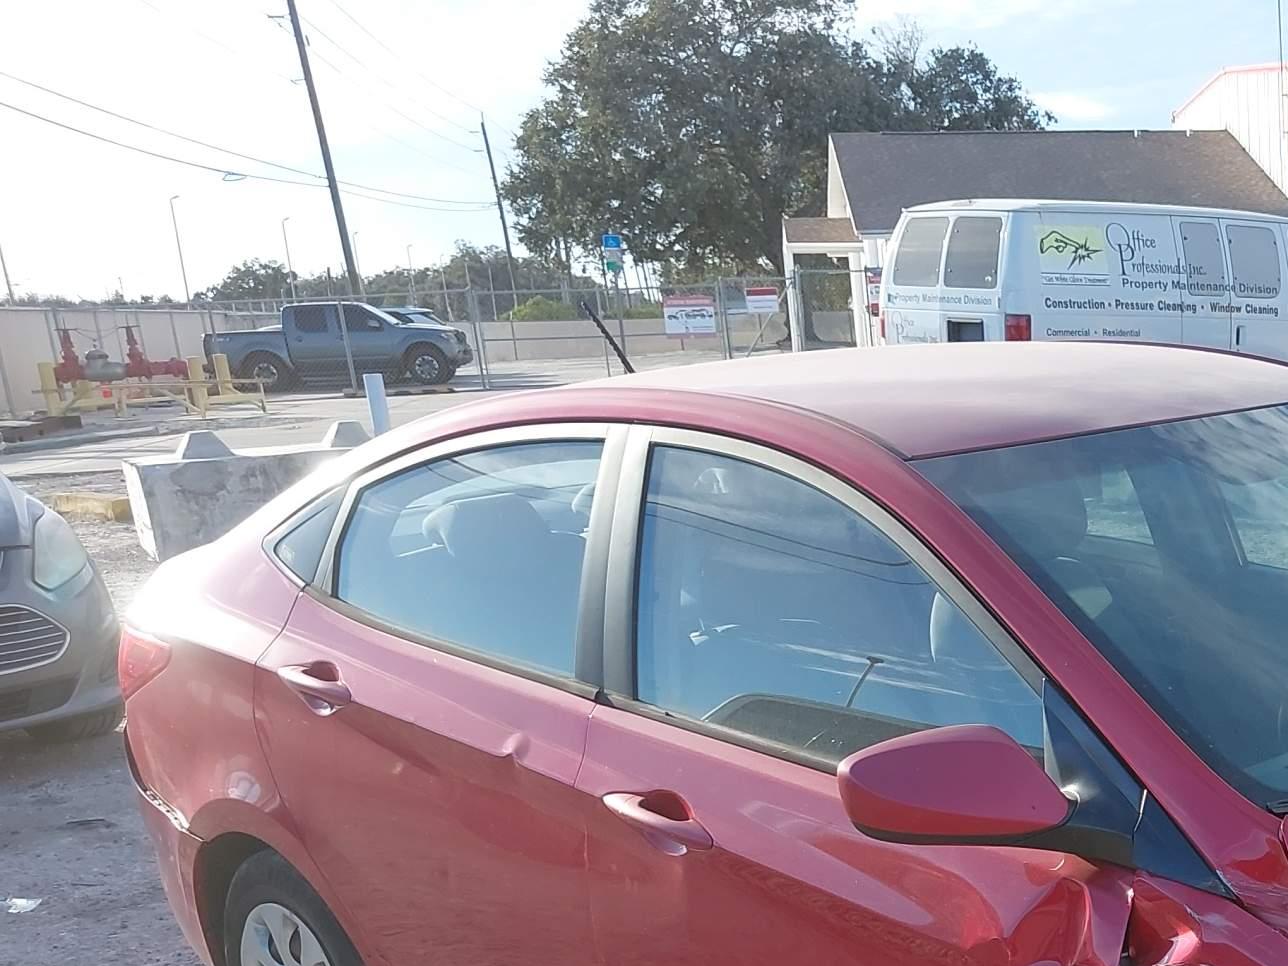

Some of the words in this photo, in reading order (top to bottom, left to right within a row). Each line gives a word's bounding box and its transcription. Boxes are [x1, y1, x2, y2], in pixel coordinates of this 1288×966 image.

[1105, 222, 1157, 252] Office
[1117, 243, 1187, 277] Professionals
[1121, 278, 1168, 292] Property
[1171, 280, 1236, 293] Maintenance
[1239, 283, 1278, 295] Division
[922, 293, 962, 304] Maintenance
[963, 294, 993, 306] Division
[1044, 297, 1106, 310] Construction
[1115, 299, 1155, 312] Pressure
[1157, 301, 1198, 314] Cleaning
[1209, 302, 1242, 313] Window
[1245, 303, 1279, 317] Cleaning
[1046, 328, 1091, 337] Commercial
[1102, 328, 1142, 338] Residential
